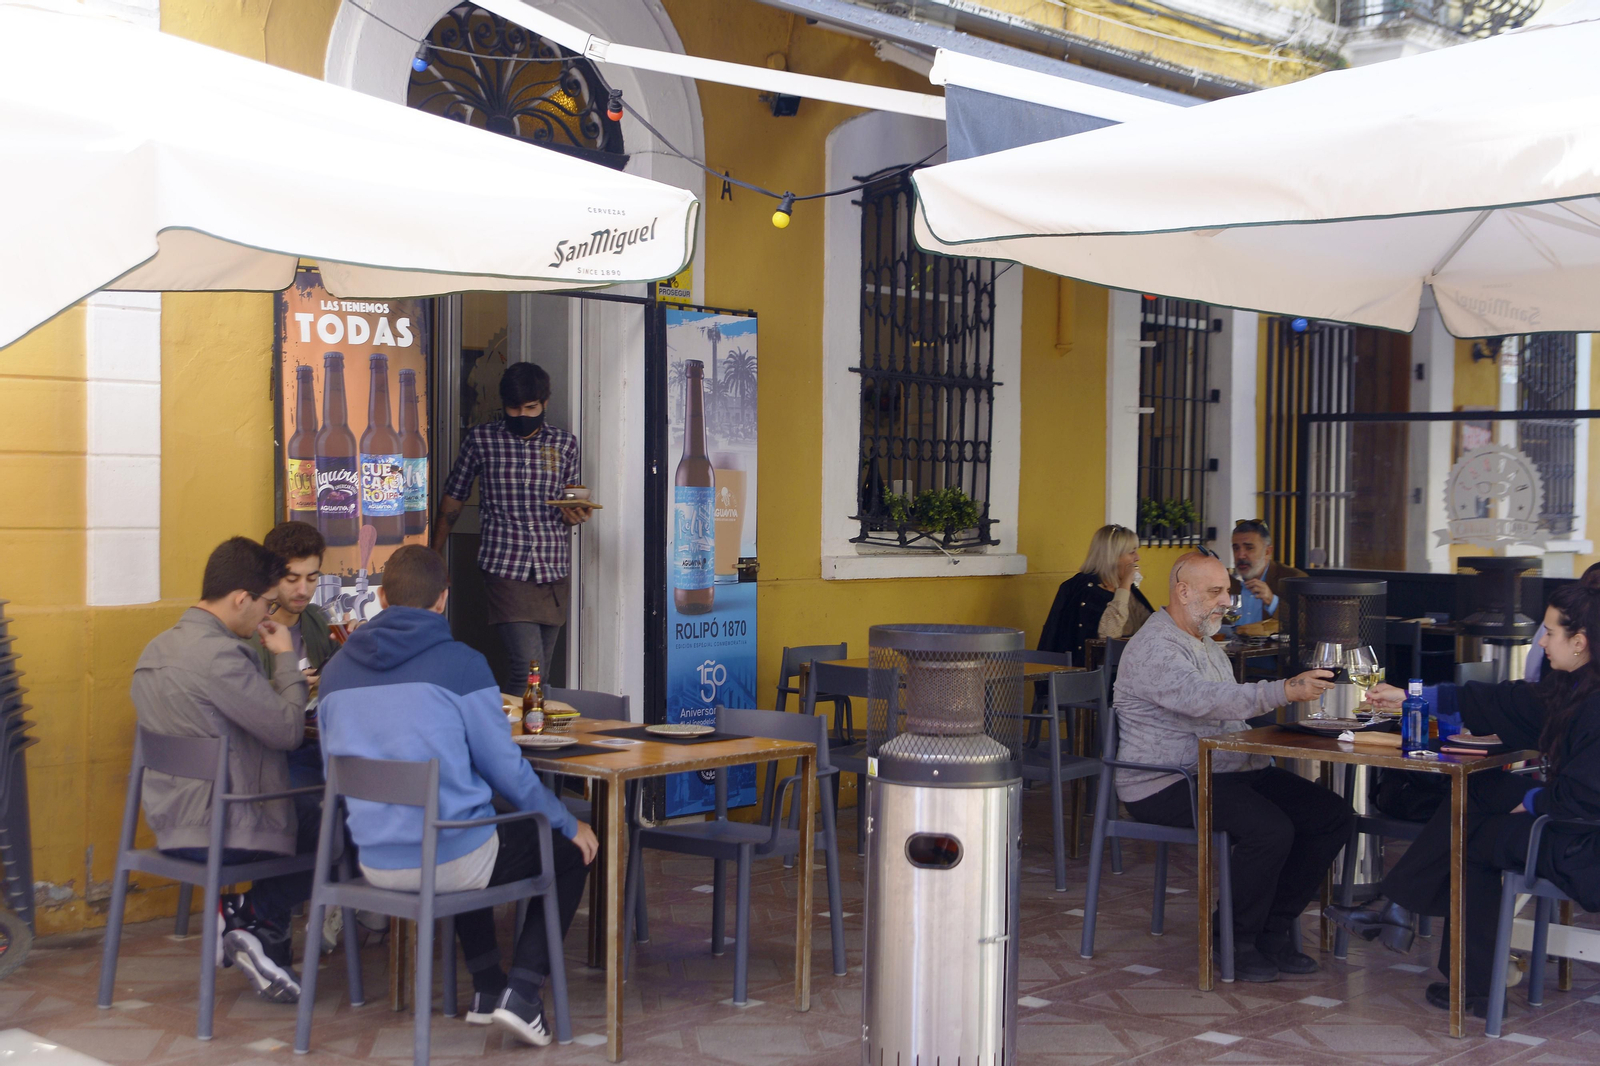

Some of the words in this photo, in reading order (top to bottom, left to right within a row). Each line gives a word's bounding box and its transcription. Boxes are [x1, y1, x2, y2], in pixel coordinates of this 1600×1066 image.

[721, 171, 732, 201] A
[587, 207, 626, 216] CERVEZAS
[658, 288, 691, 298] PROSEGUR
[320, 300, 340, 312] LAS
[341, 301, 390, 314] TENEMOS
[294, 312, 414, 348] TODAS
[675, 617, 719, 640] ROLIPÓ
[722, 620, 747, 637] 1870
[696, 659, 727, 703] 150
